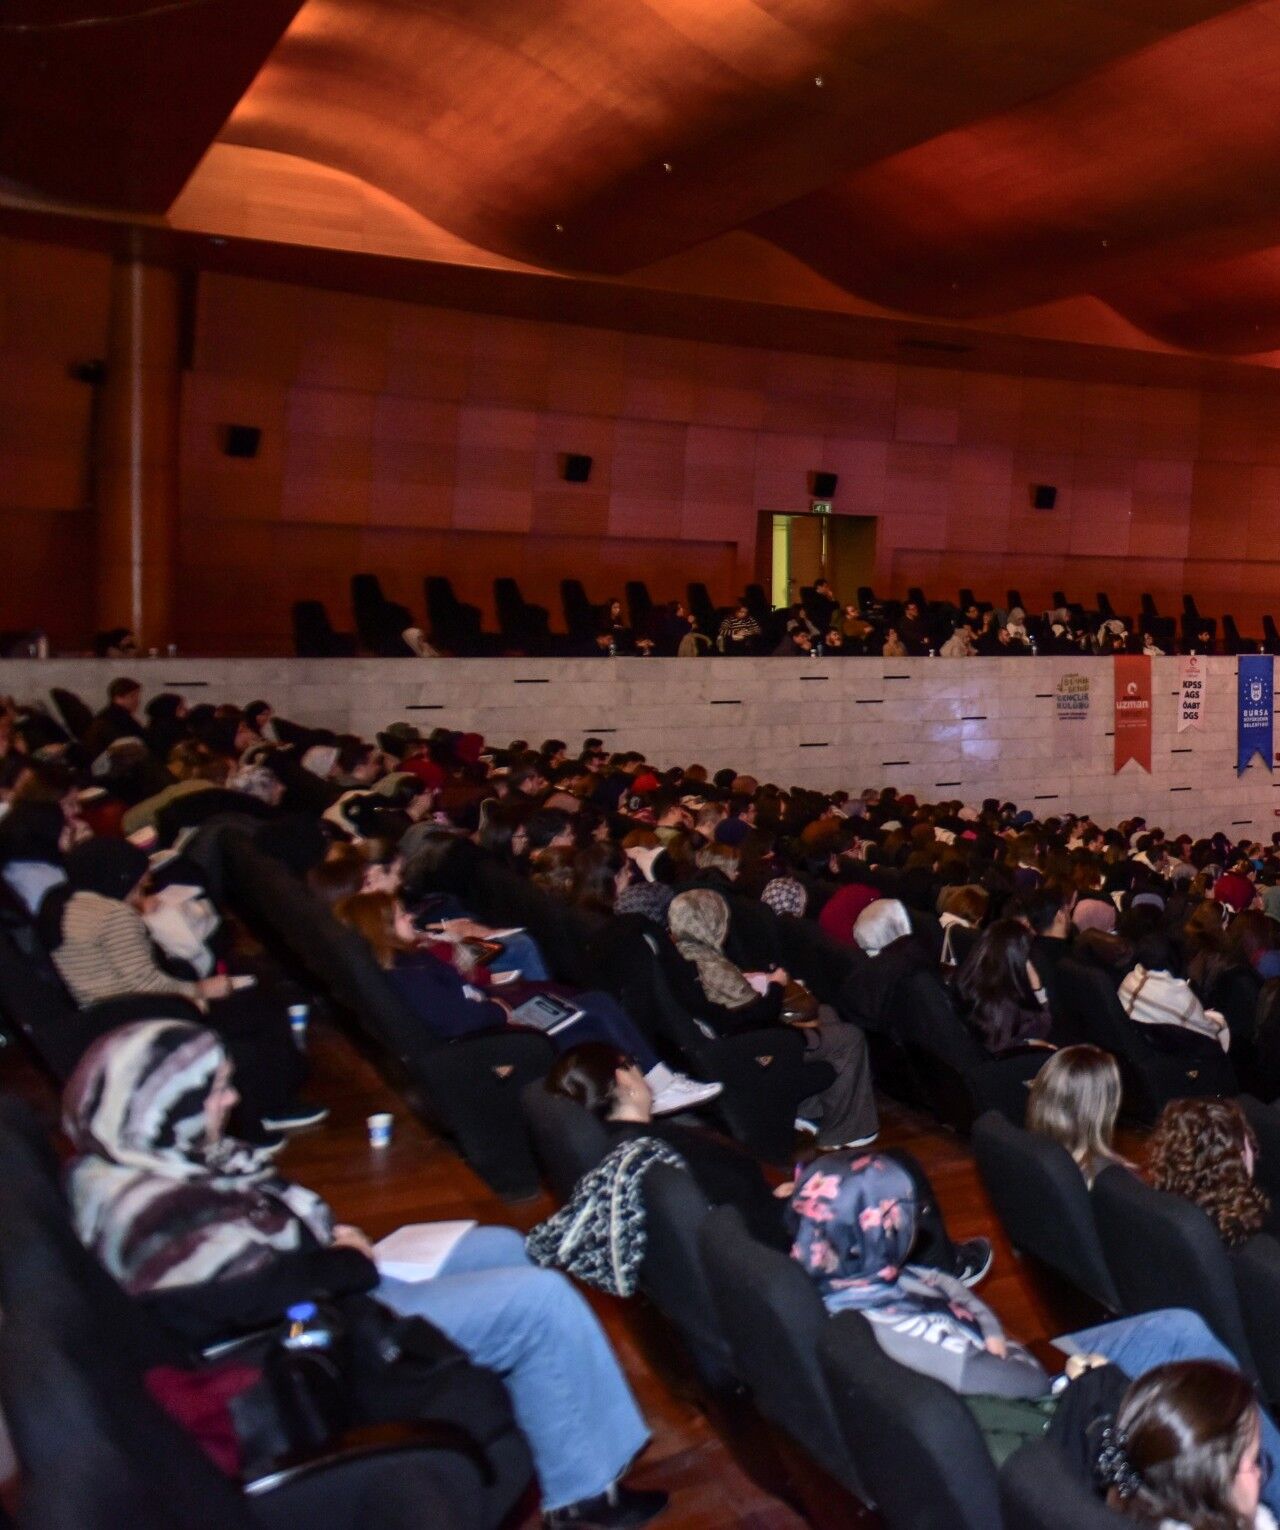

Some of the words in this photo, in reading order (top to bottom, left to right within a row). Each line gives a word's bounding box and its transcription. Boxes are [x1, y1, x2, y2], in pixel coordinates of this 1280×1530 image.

[1182, 681, 1202, 689] KPSS
[1184, 690, 1200, 698] AGS
[1116, 700, 1149, 709] uzman
[1183, 701, 1200, 709] ÖABT
[1183, 711, 1199, 720] DGS
